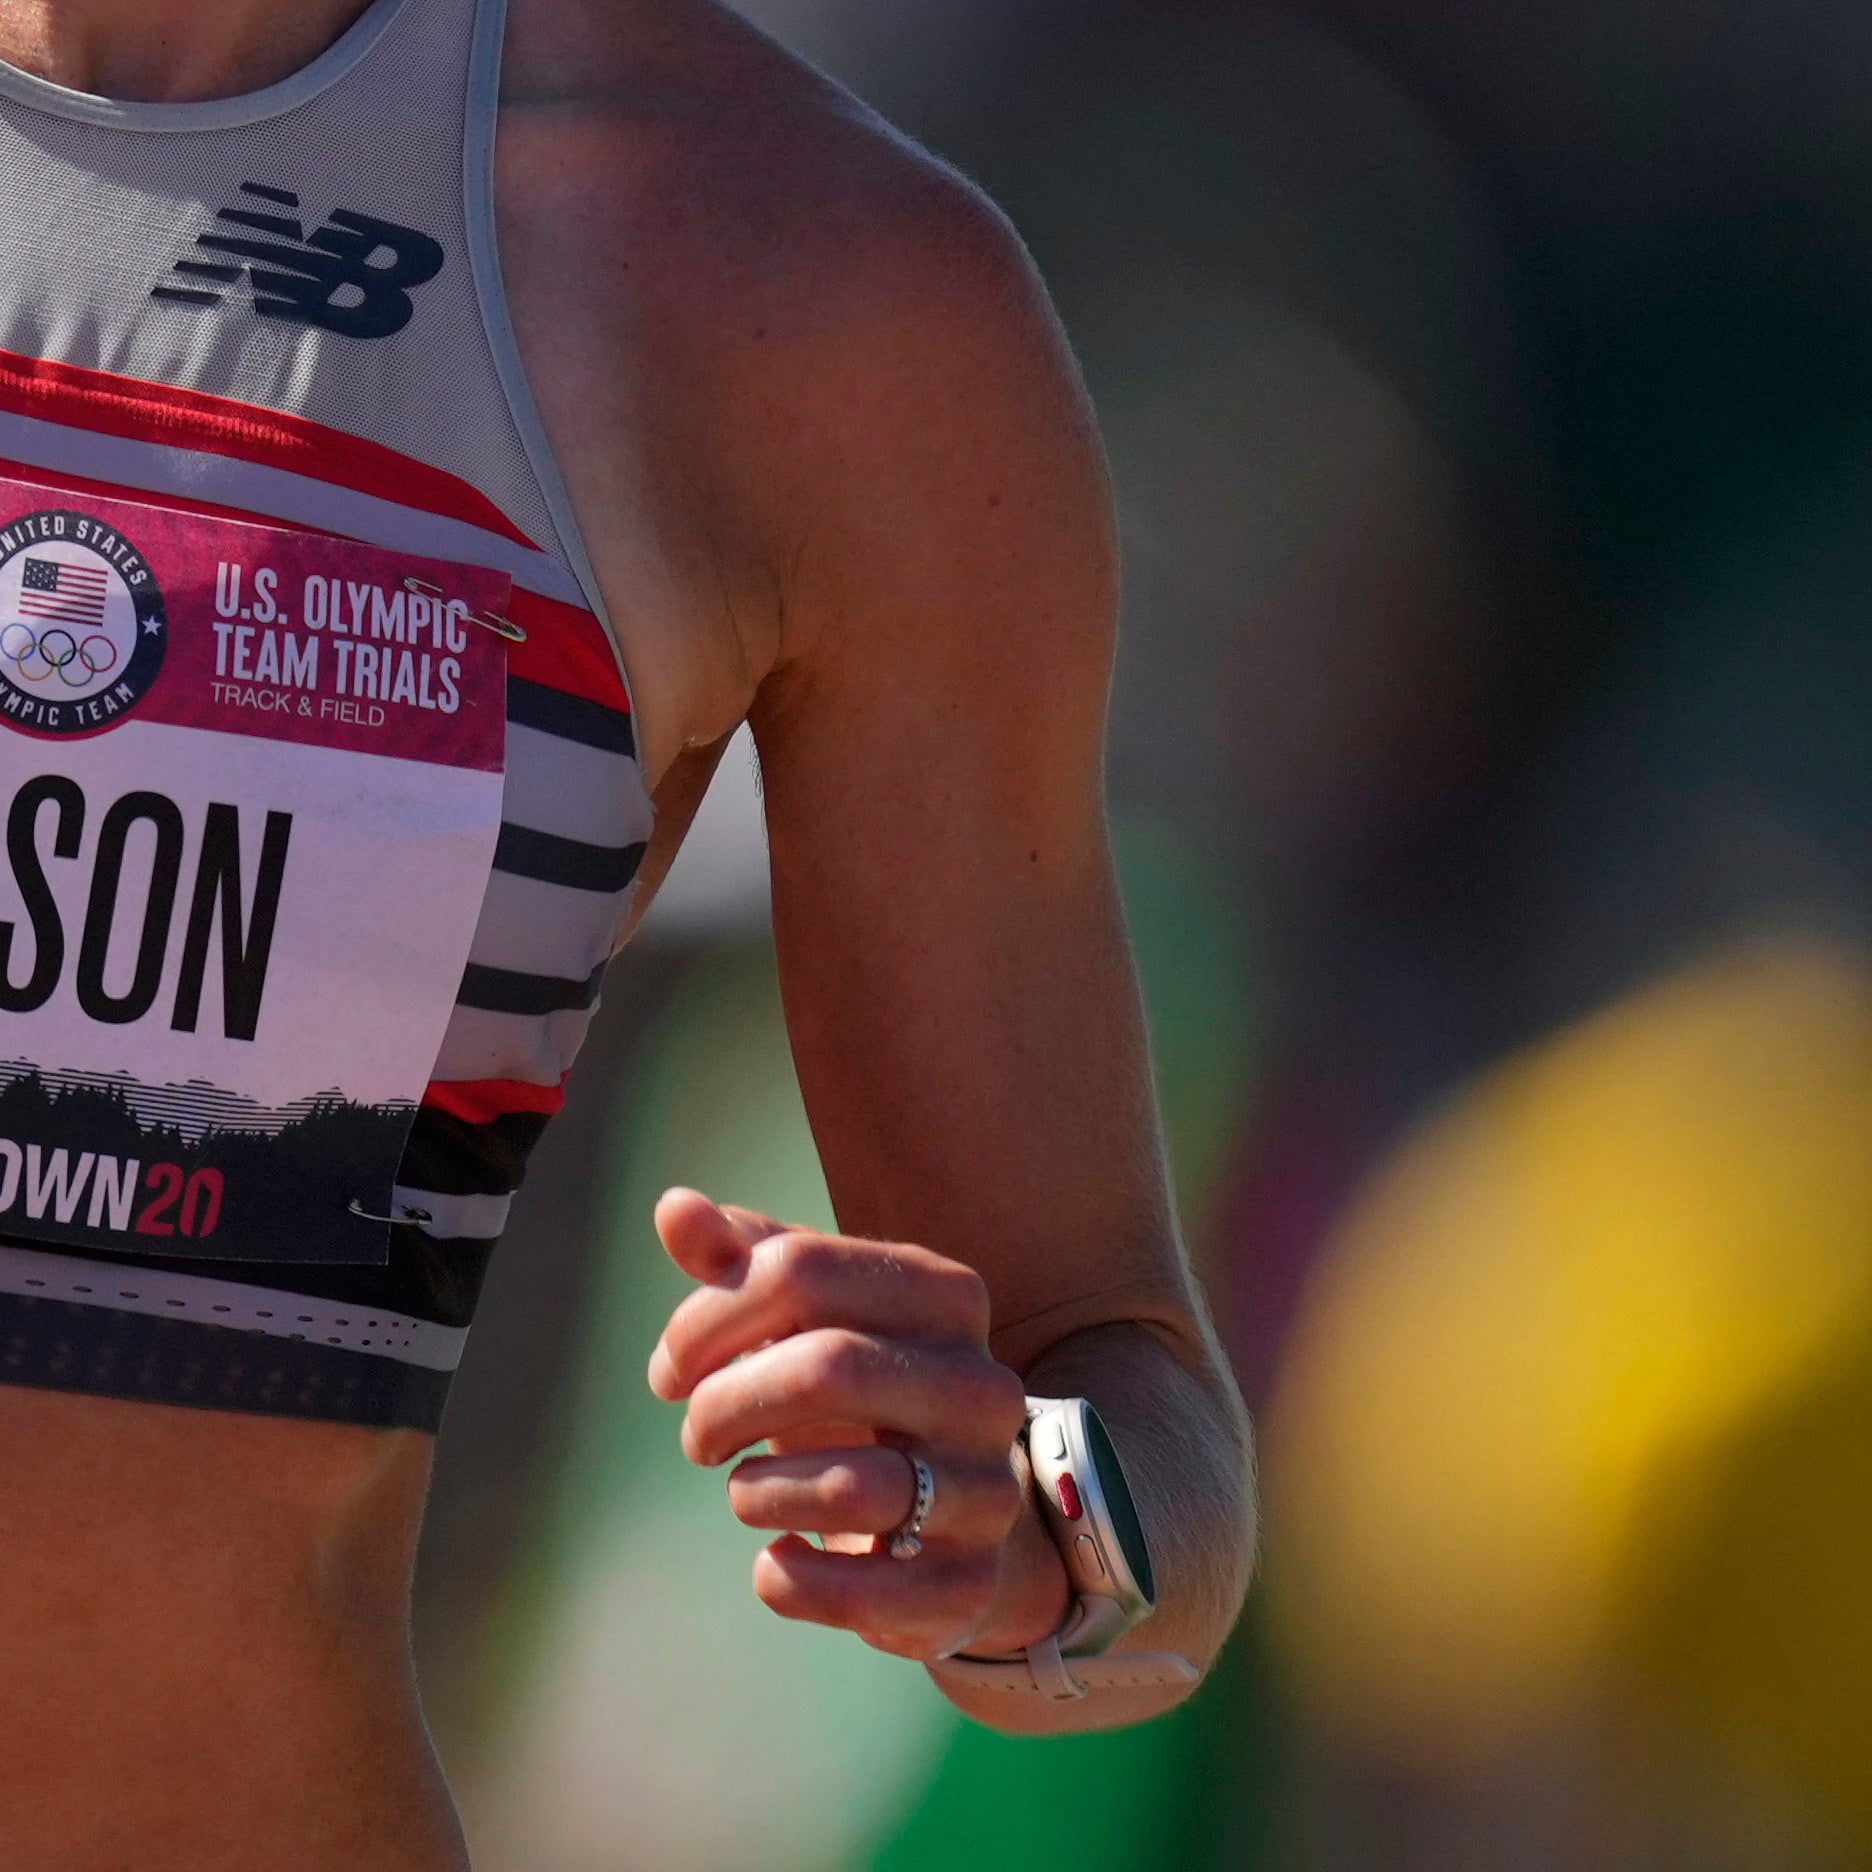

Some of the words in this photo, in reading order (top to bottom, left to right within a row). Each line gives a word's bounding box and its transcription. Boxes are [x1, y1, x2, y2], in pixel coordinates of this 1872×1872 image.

[76, 519, 148, 586] STATES
[215, 561, 288, 625] U.S.
[304, 574, 468, 654] OLYMPIC
[212, 622, 319, 690] TEAM
[333, 640, 461, 714] TRIALS
[75, 682, 135, 725] TEAM
[209, 682, 291, 714] TRACK
[297, 695, 313, 718] &
[320, 699, 386, 727] FIELD
